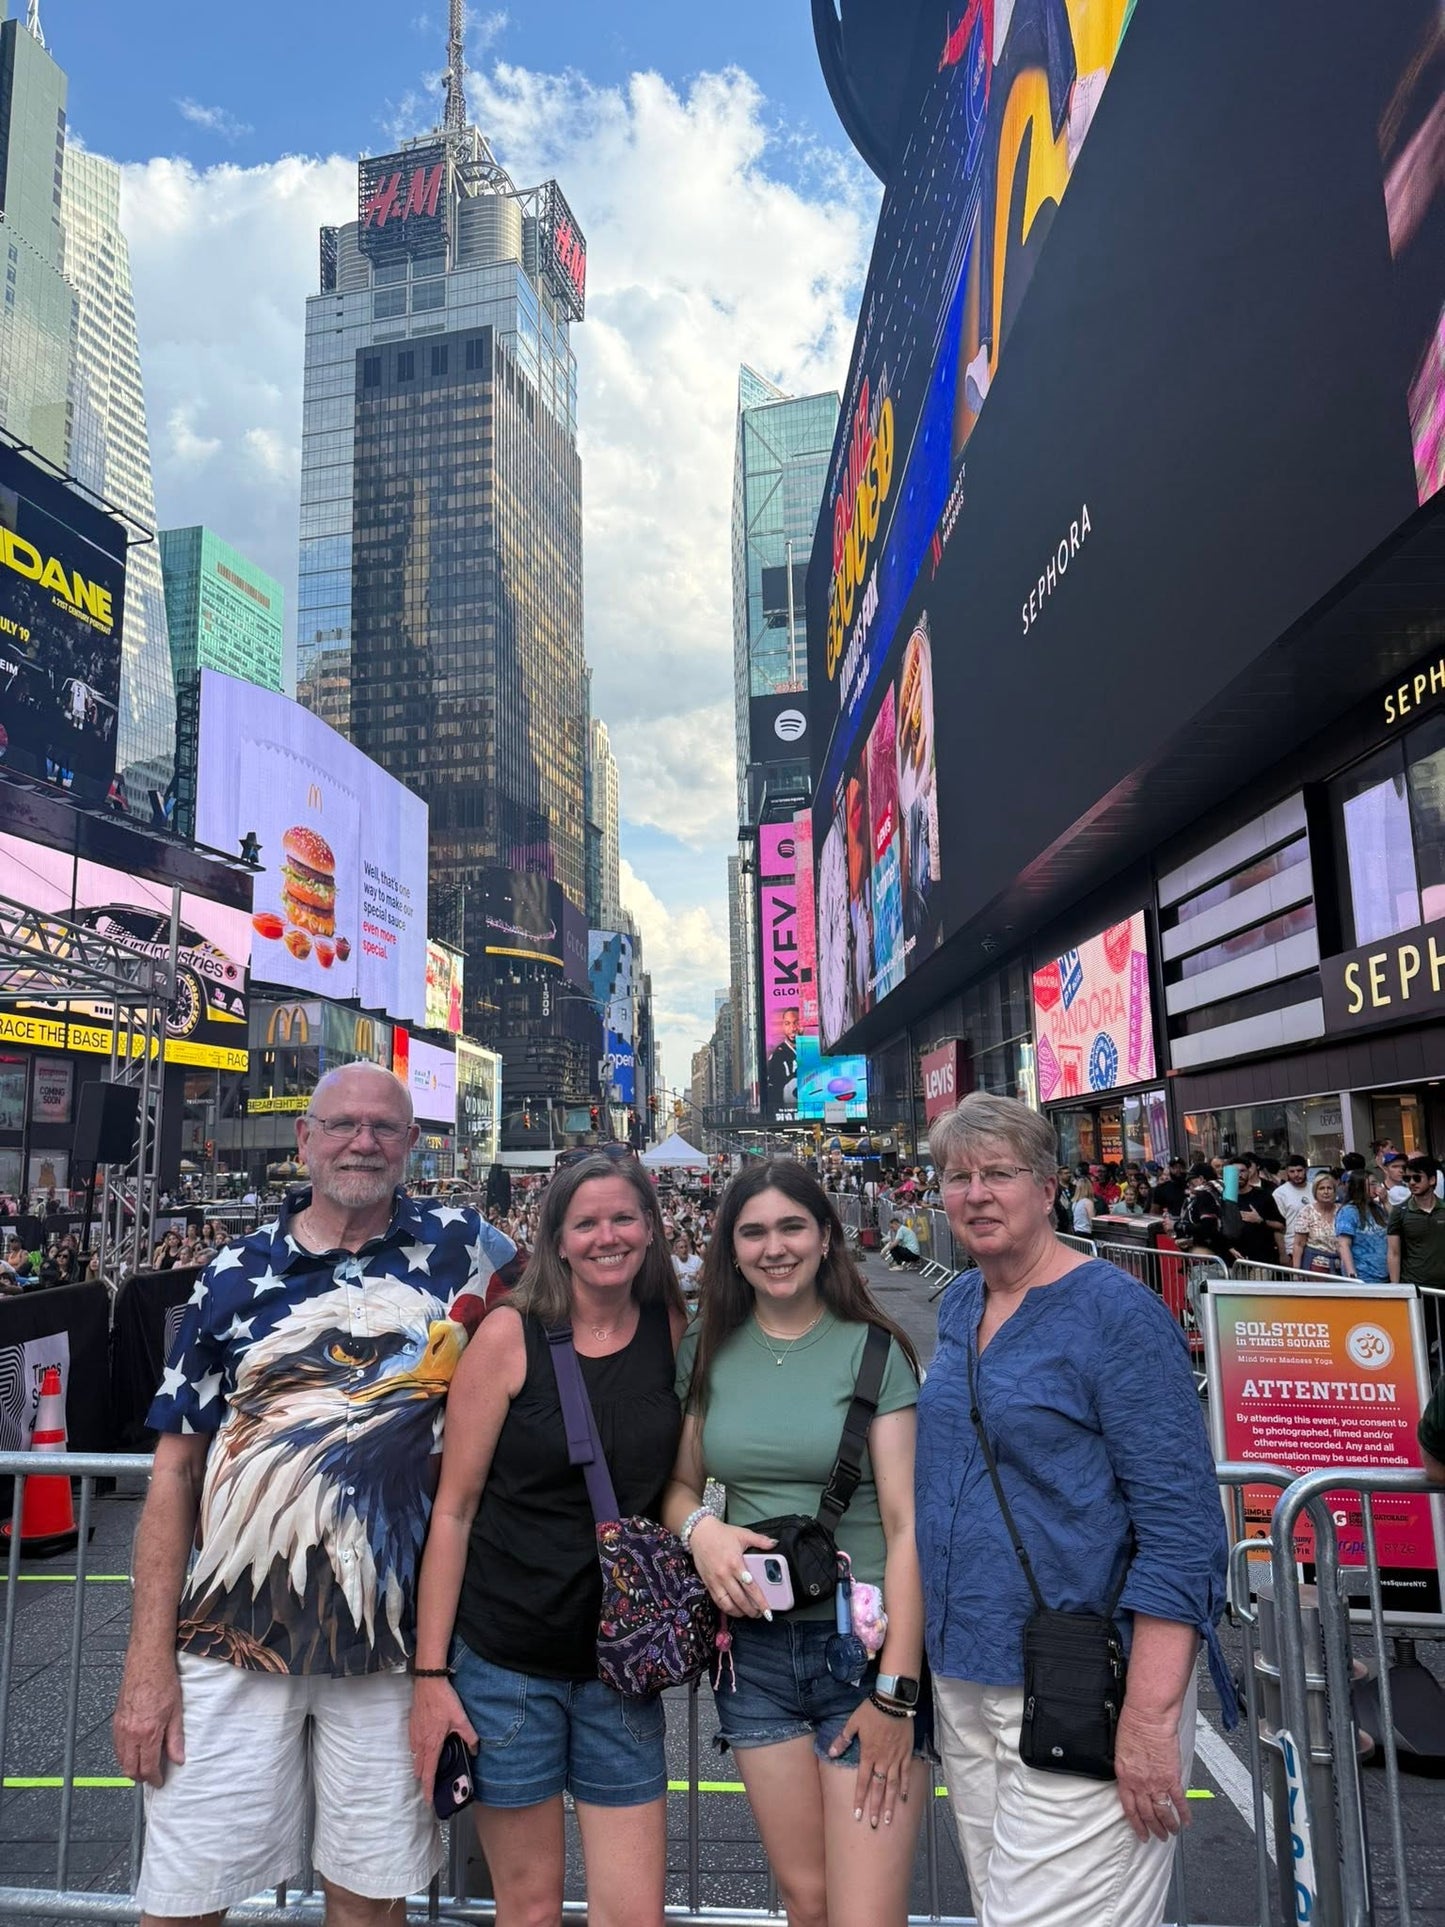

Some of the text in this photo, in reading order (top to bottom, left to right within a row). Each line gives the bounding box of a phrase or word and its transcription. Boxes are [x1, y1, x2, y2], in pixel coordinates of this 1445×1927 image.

[364, 163, 445, 228] H&M
[556, 217, 586, 296] H&M
[827, 396, 895, 681] BALLS!
[1022, 503, 1092, 635] SEPHORA
[19, 626, 31, 642] 19
[1384, 658, 1445, 724] SEPH
[363, 860, 411, 899] Well, that's one
[363, 882, 414, 918] way to make our
[363, 901, 406, 931] special sauce
[363, 920, 397, 945] even more
[363, 939, 388, 960] special.
[1344, 936, 1445, 1014] SEPH
[542, 982, 550, 1016] 1500
[1051, 982, 1127, 1043] PANDORA
[39, 1024, 70, 1044] THE
[73, 1029, 109, 1049] BASE
[40, 1086, 66, 1097] COMING
[43, 1095, 62, 1105] SOON
[1235, 1321, 1330, 1338] SOLSTICE
[1236, 1337, 1331, 1348] in TIMES SQUARE
[1238, 1355, 1258, 1363] Mind
[1279, 1356, 1313, 1364] Madness
[1314, 1357, 1333, 1366] Yoga
[1242, 1379, 1396, 1402] ATTENTION
[1236, 1413, 1408, 1428] By attending this event, you consent to
[1252, 1426, 1394, 1439] be photographed, filmed and/or
[1243, 1450, 1408, 1464] documentation may be used in media
[1254, 1438, 1395, 1452] otherwise recorded. Any and all
